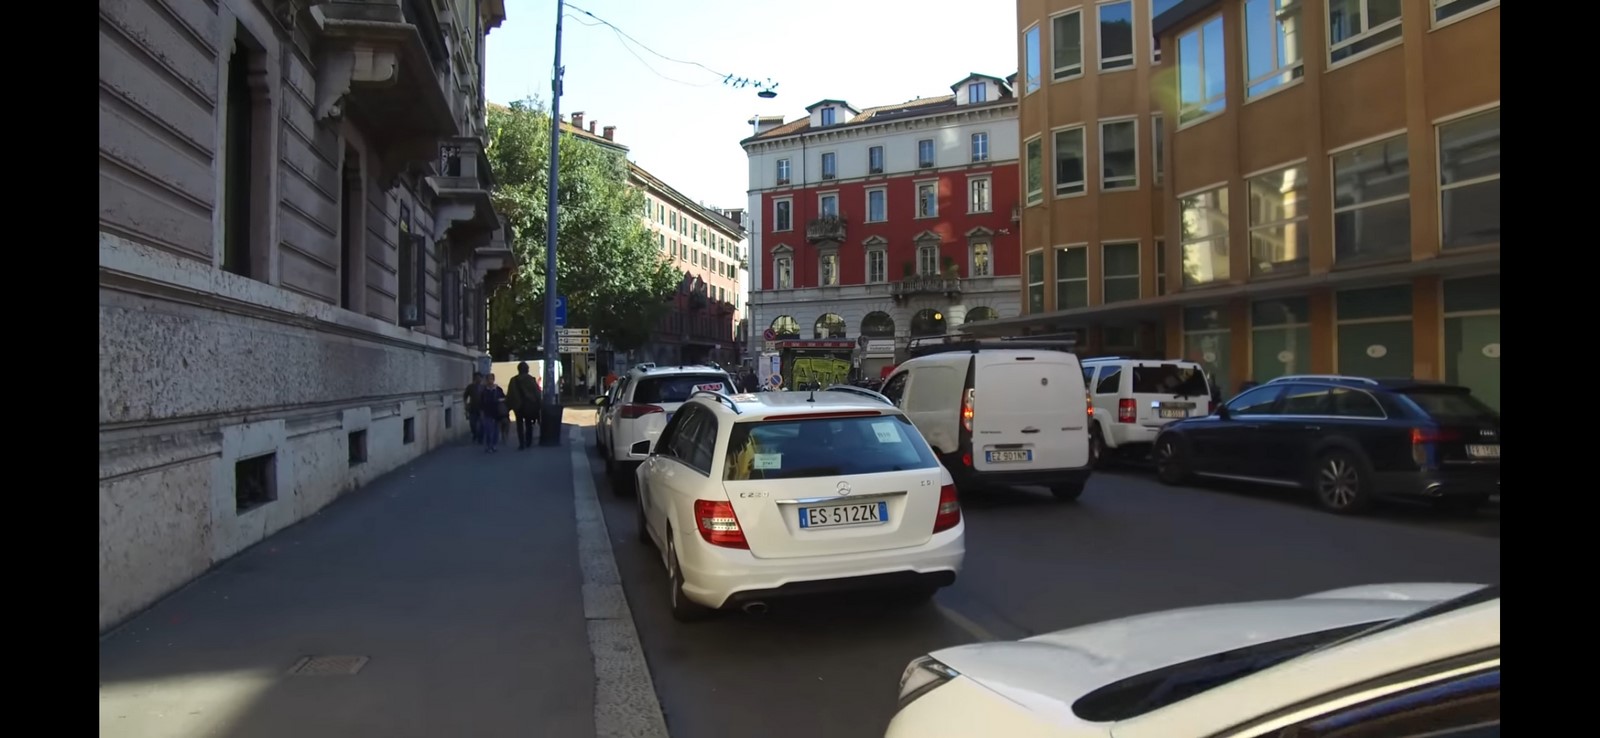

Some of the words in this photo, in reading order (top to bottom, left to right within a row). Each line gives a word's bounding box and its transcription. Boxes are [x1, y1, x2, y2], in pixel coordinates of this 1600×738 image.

[699, 383, 721, 391] TAXI
[809, 508, 828, 525] ES
[833, 504, 878, 523] 512ZK
